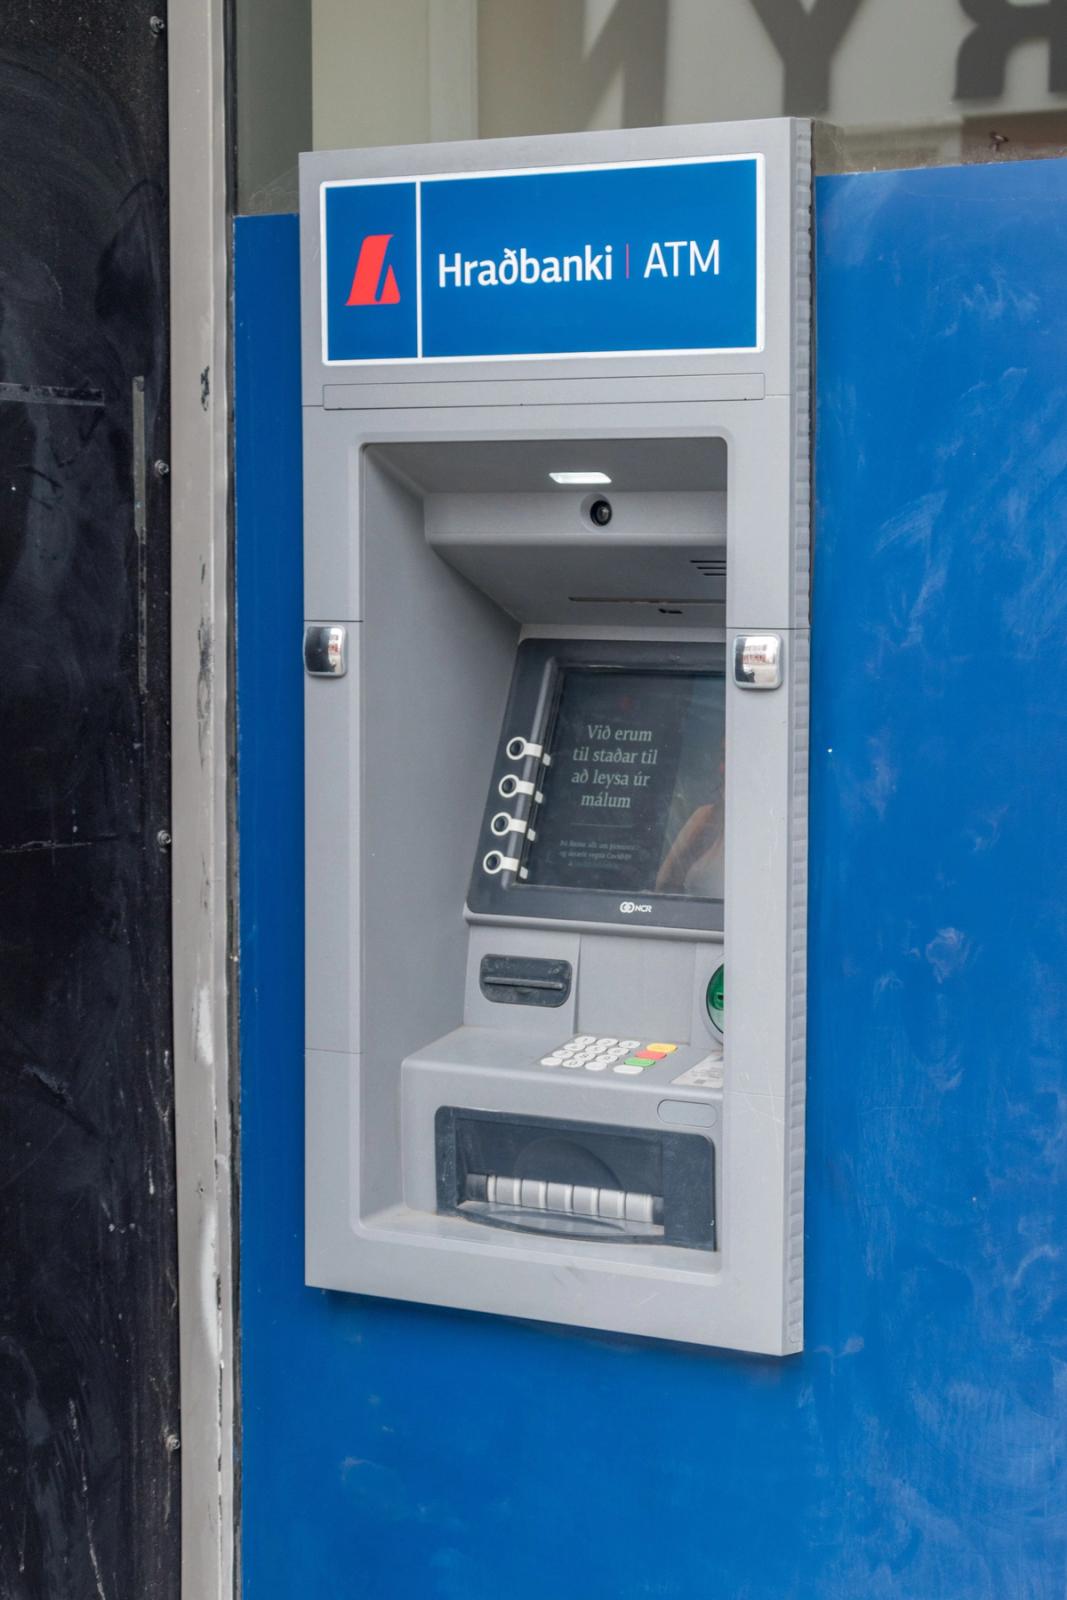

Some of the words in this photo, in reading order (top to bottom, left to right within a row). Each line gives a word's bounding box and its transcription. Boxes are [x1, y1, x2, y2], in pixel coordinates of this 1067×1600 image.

[438, 244, 613, 288] Hraðbanki
[643, 239, 720, 279] ATM
[587, 724, 611, 741] Við
[614, 729, 653, 742] erum
[572, 746, 590, 761] til
[592, 747, 639, 763] staðar
[640, 748, 659, 765] til
[571, 768, 589, 784] að
[592, 769, 629, 789] leysa
[633, 770, 651, 786] úr
[580, 791, 632, 809] málum
[634, 904, 653, 913] NCR
